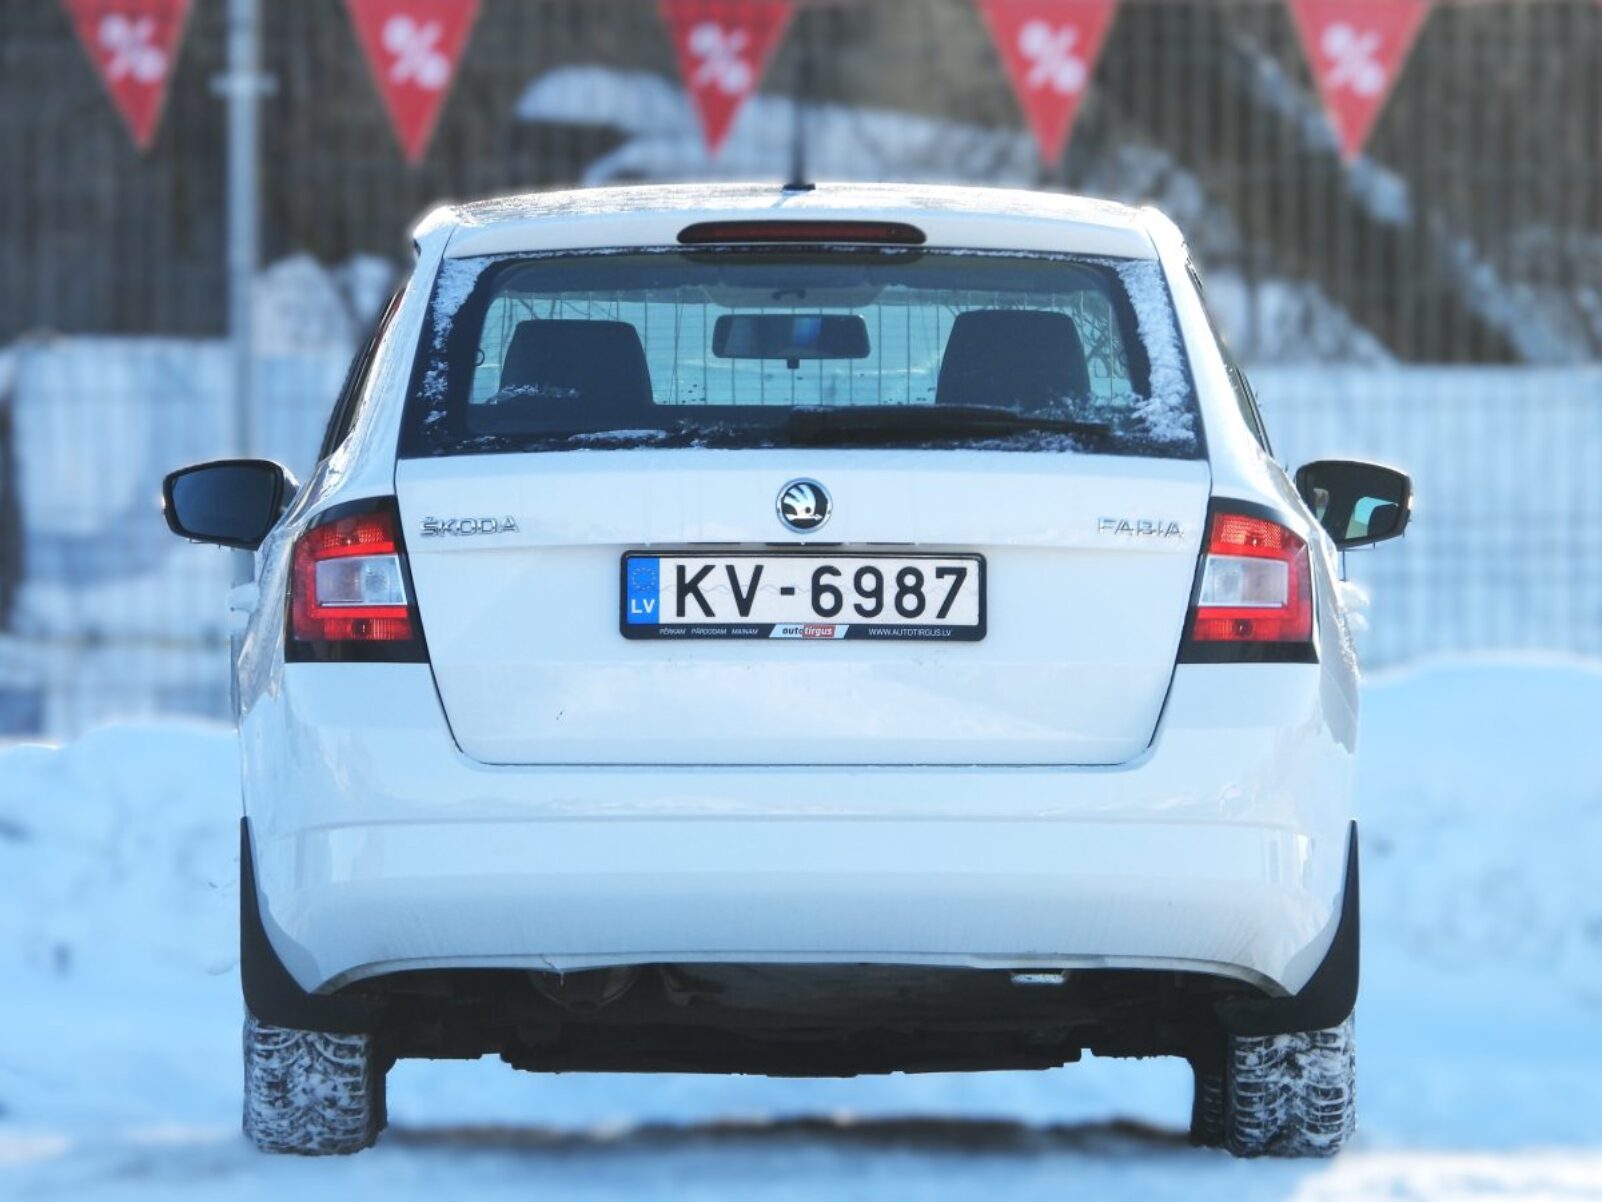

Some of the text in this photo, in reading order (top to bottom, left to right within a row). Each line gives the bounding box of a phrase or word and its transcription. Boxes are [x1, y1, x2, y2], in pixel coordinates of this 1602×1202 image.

[420, 516, 520, 537] ŠKODA
[1097, 517, 1184, 537] FABIA
[631, 599, 655, 614] LV
[868, 628, 952, 637] WWW.AUTOTIRGUS.LV
